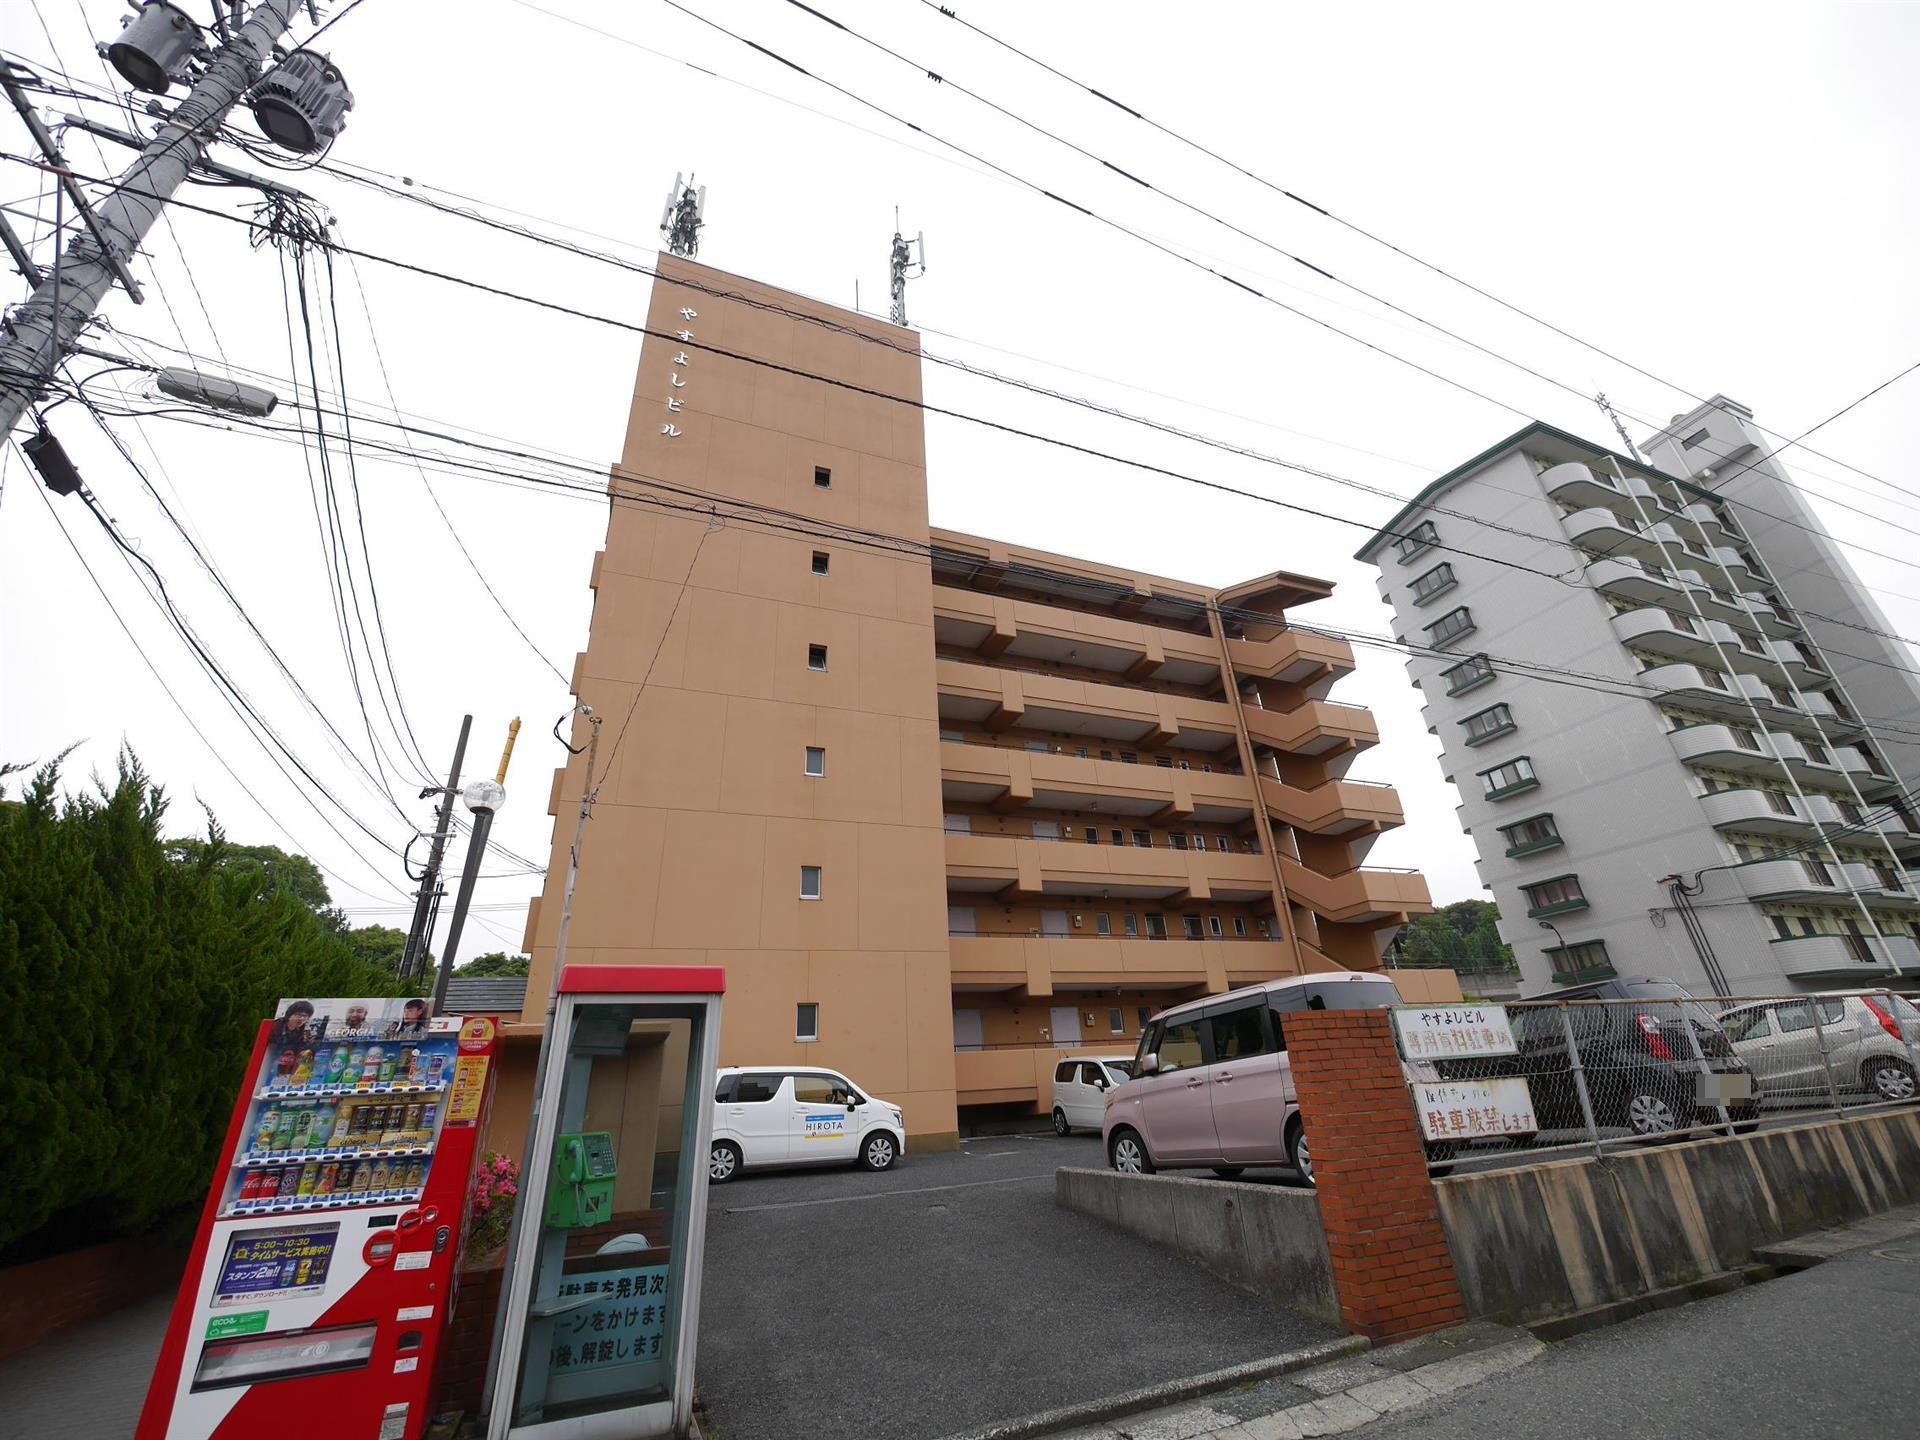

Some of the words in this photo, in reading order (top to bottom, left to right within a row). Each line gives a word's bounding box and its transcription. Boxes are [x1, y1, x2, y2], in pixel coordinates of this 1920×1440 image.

[660, 307, 697, 437] やすよしビル
[1421, 1011, 1485, 1027] やすよしビル
[806, 1122, 843, 1131] HIROTA
[1428, 1106, 1532, 1137] 駐車厳禁します
[558, 1274, 669, 1301] 駐車を発見次
[549, 1333, 663, 1368] 後、解錠します
